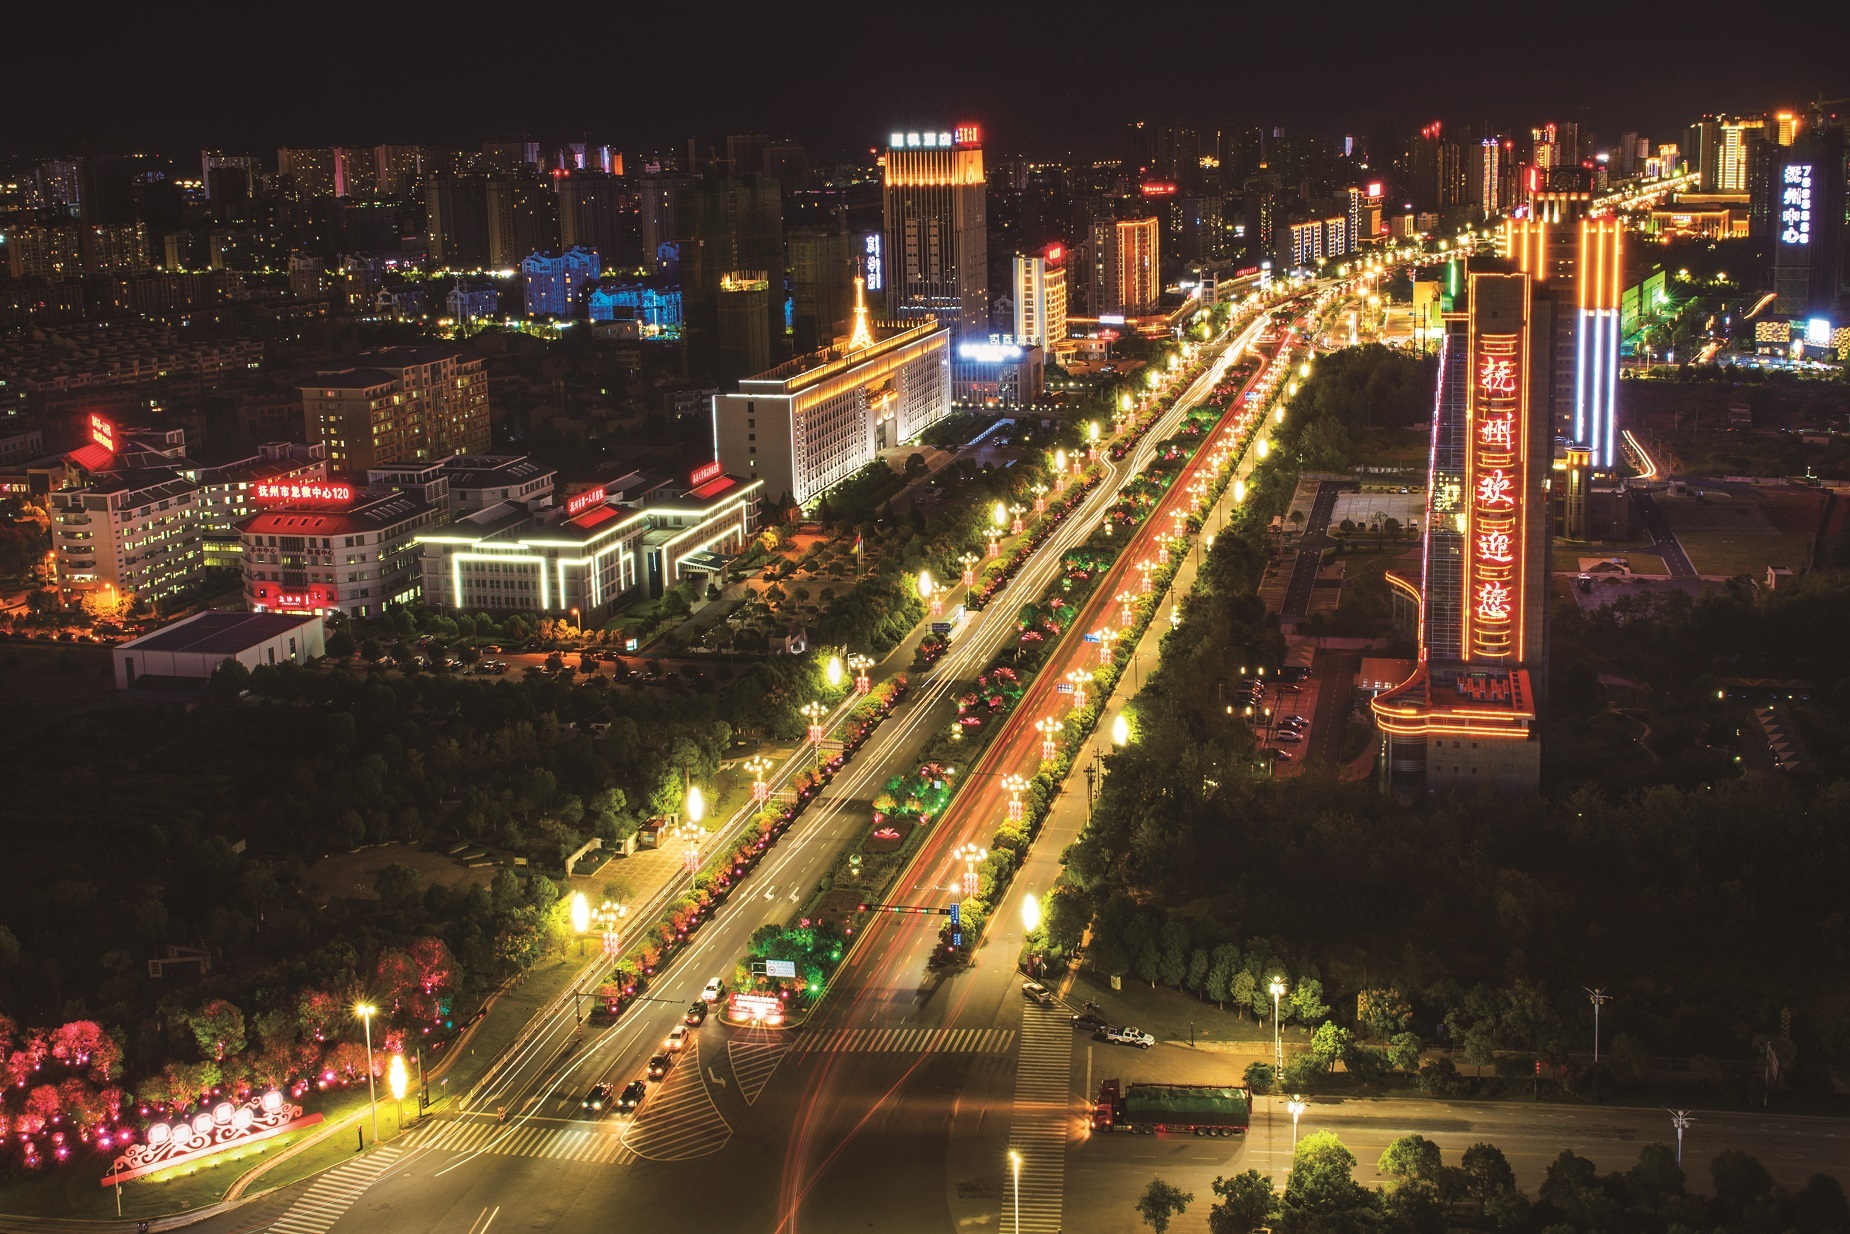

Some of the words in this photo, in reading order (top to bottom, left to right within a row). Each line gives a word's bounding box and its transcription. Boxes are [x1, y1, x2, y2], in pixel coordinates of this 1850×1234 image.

[1782, 165, 1803, 243] 抚州中心
[258, 485, 349, 499] 抚州市急救中心120
[570, 488, 604, 513] 抚州市第一人民医院
[1477, 356, 1516, 618] 抚州欢迎您
